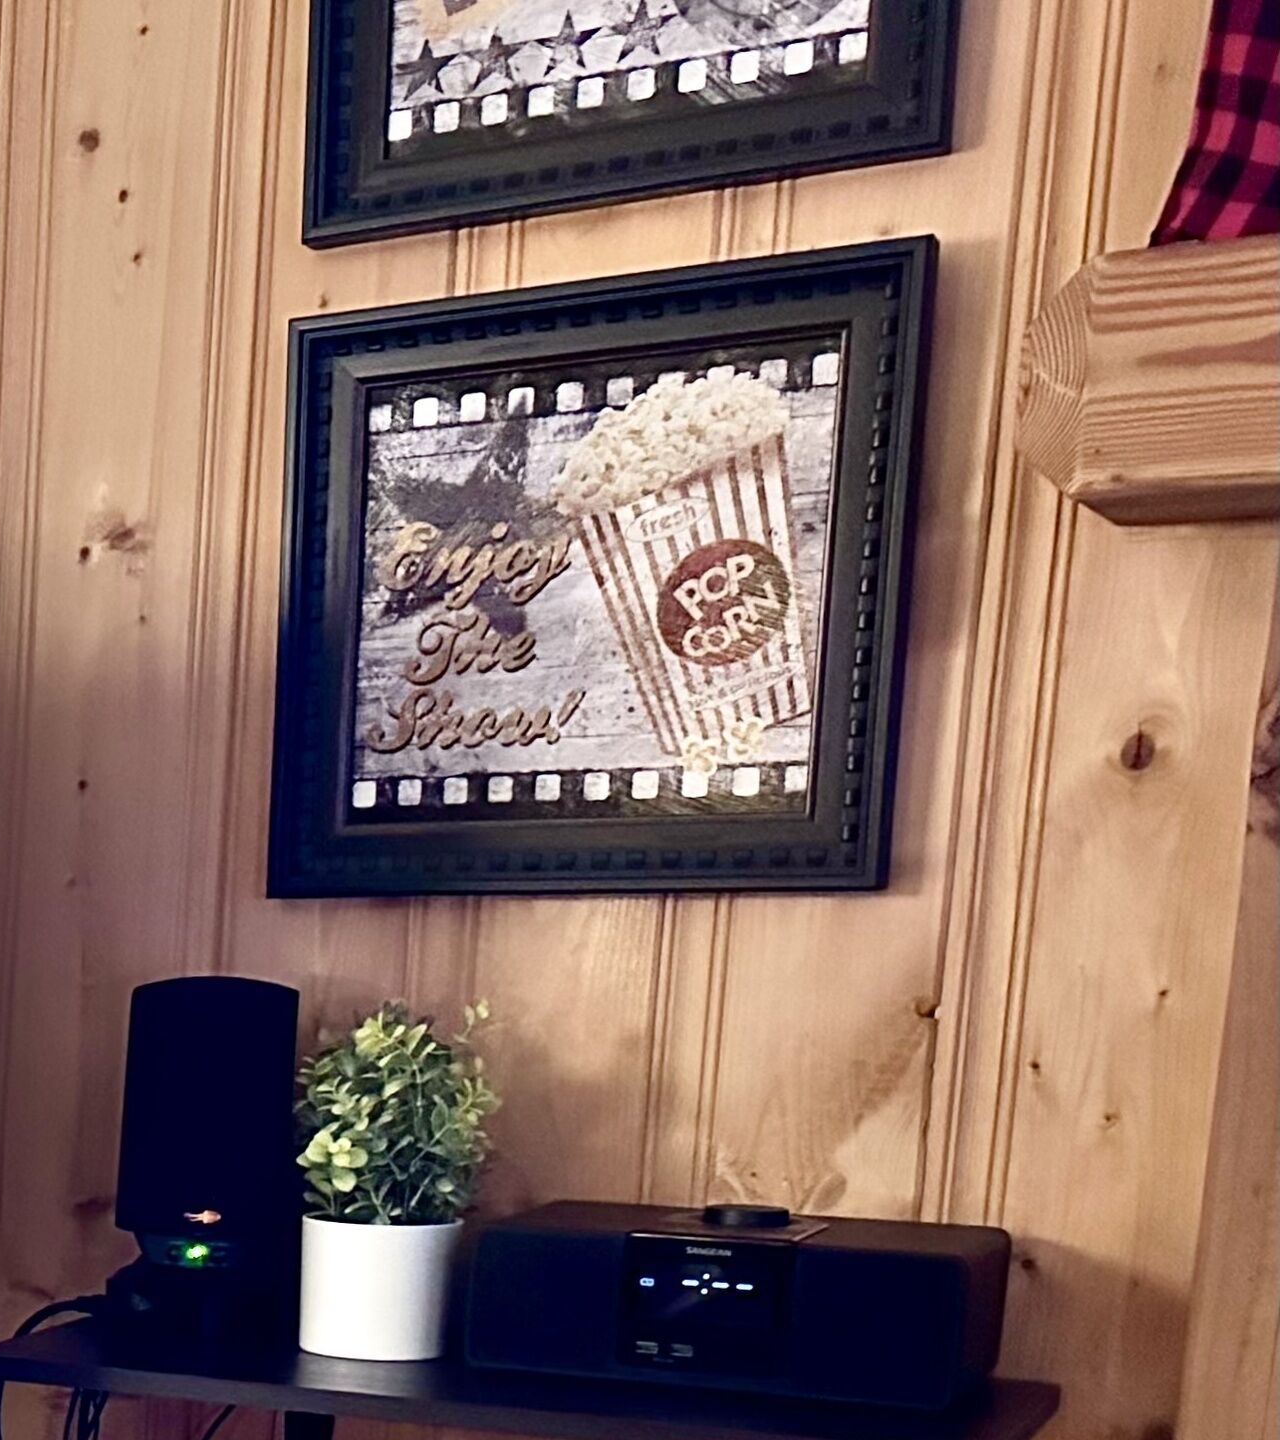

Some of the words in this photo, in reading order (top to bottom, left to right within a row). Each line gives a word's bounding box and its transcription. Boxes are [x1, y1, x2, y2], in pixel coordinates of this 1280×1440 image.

[639, 503, 697, 537] fresh
[377, 521, 572, 610] Enjoy
[673, 553, 755, 620] POP
[403, 609, 537, 686] The
[682, 580, 782, 657] CORN
[364, 688, 586, 754] Show!
